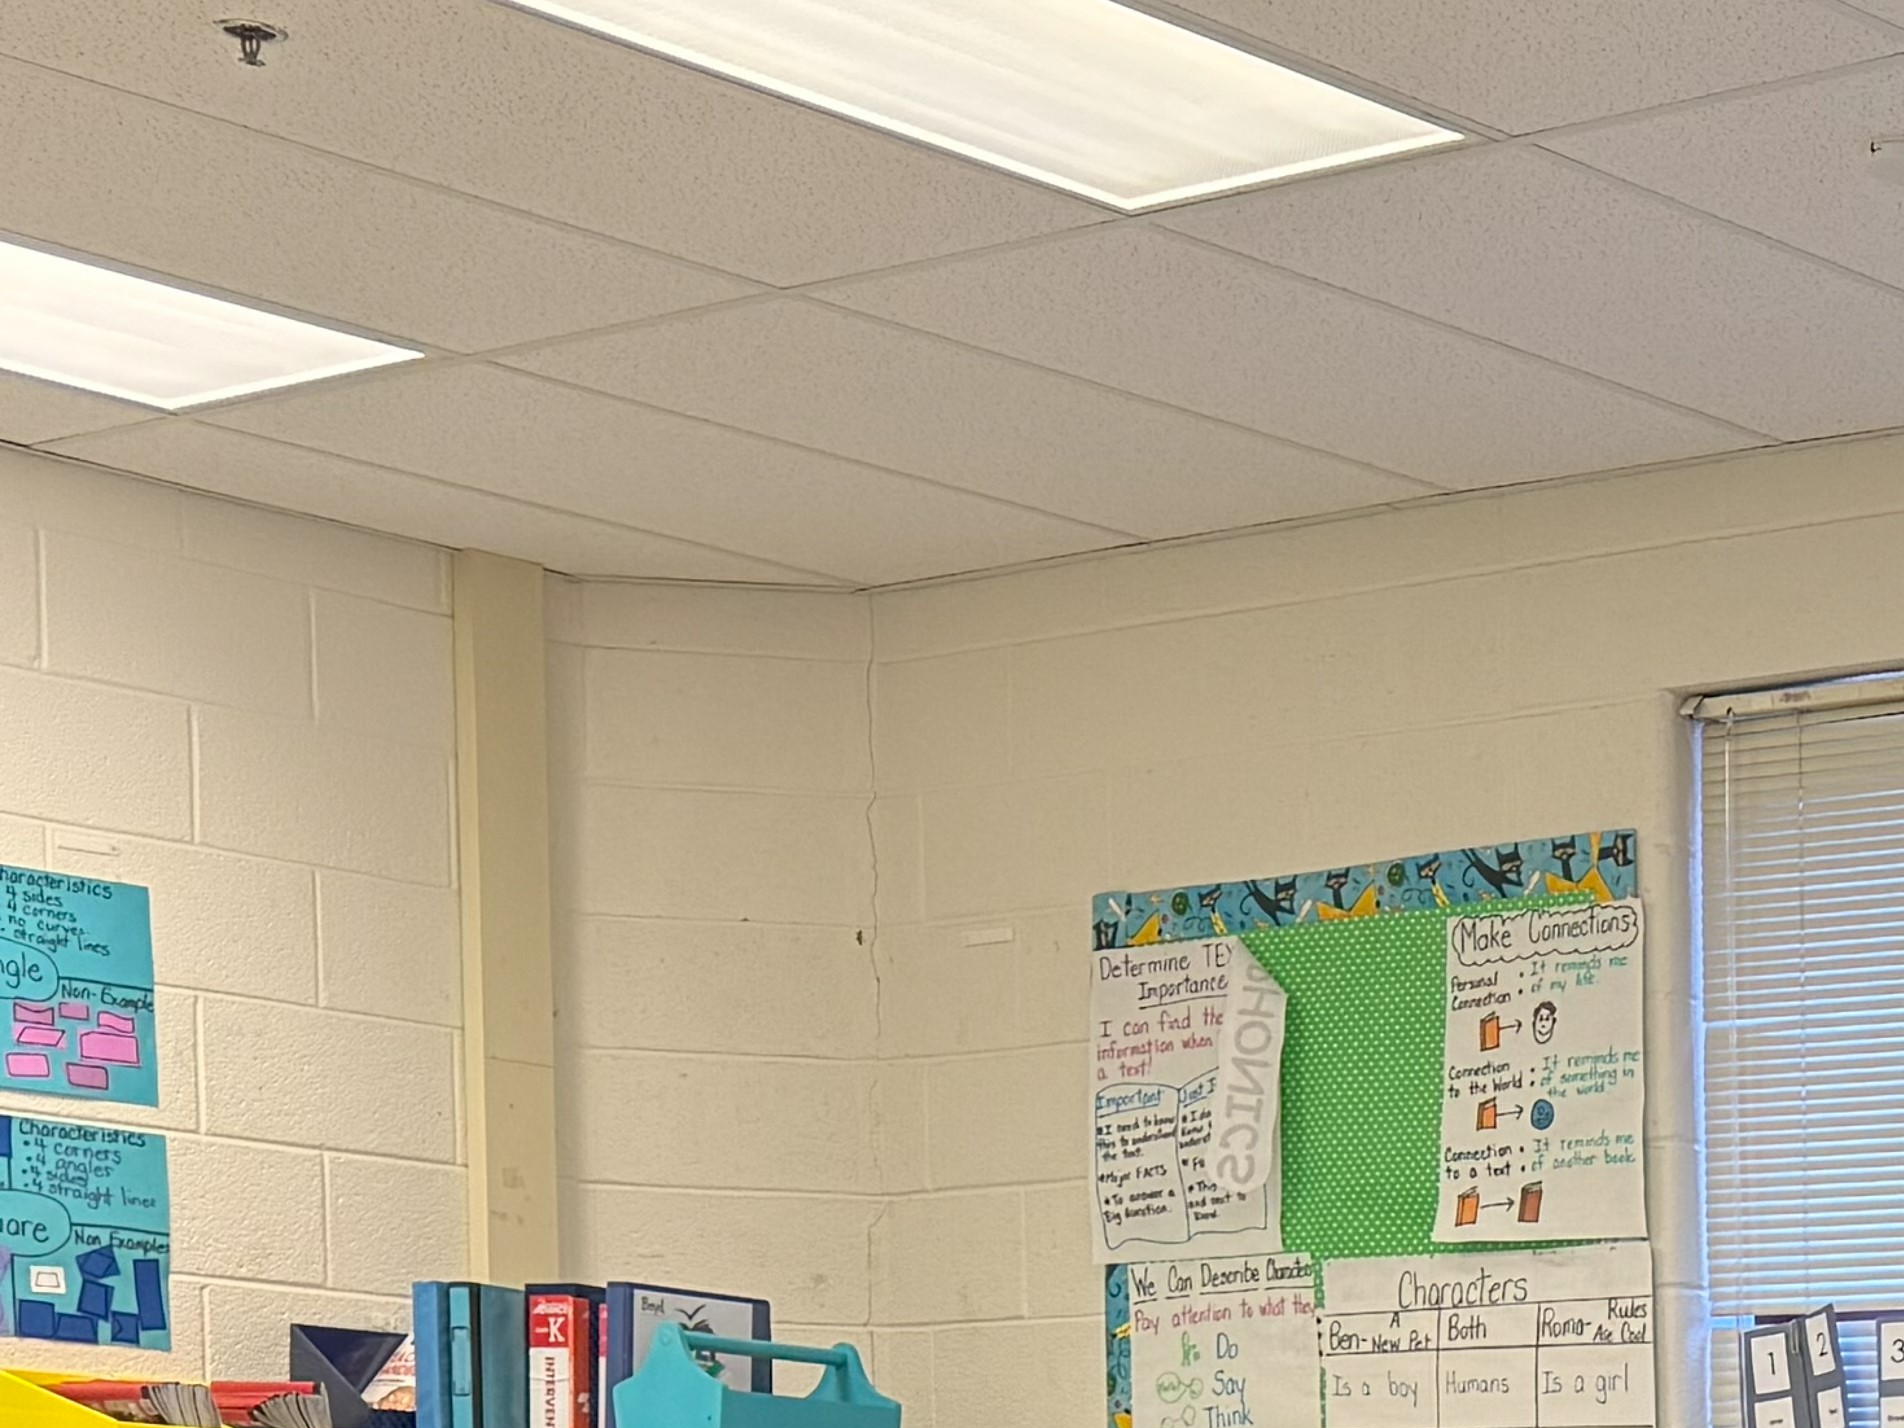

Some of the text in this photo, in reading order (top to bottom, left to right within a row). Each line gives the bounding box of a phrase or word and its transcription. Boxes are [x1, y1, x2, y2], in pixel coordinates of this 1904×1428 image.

[1459, 905, 1631, 953] Make Connections
[1399, 1270, 1528, 1309] Characters
[641, 1298, 665, 1315] Boyd
[1448, 1313, 1486, 1341] Both
[1217, 1332, 1238, 1359] Do
[1212, 1372, 1244, 1400] Say
[1446, 1371, 1509, 1393] Humans
[1206, 1406, 1253, 1427] Think
